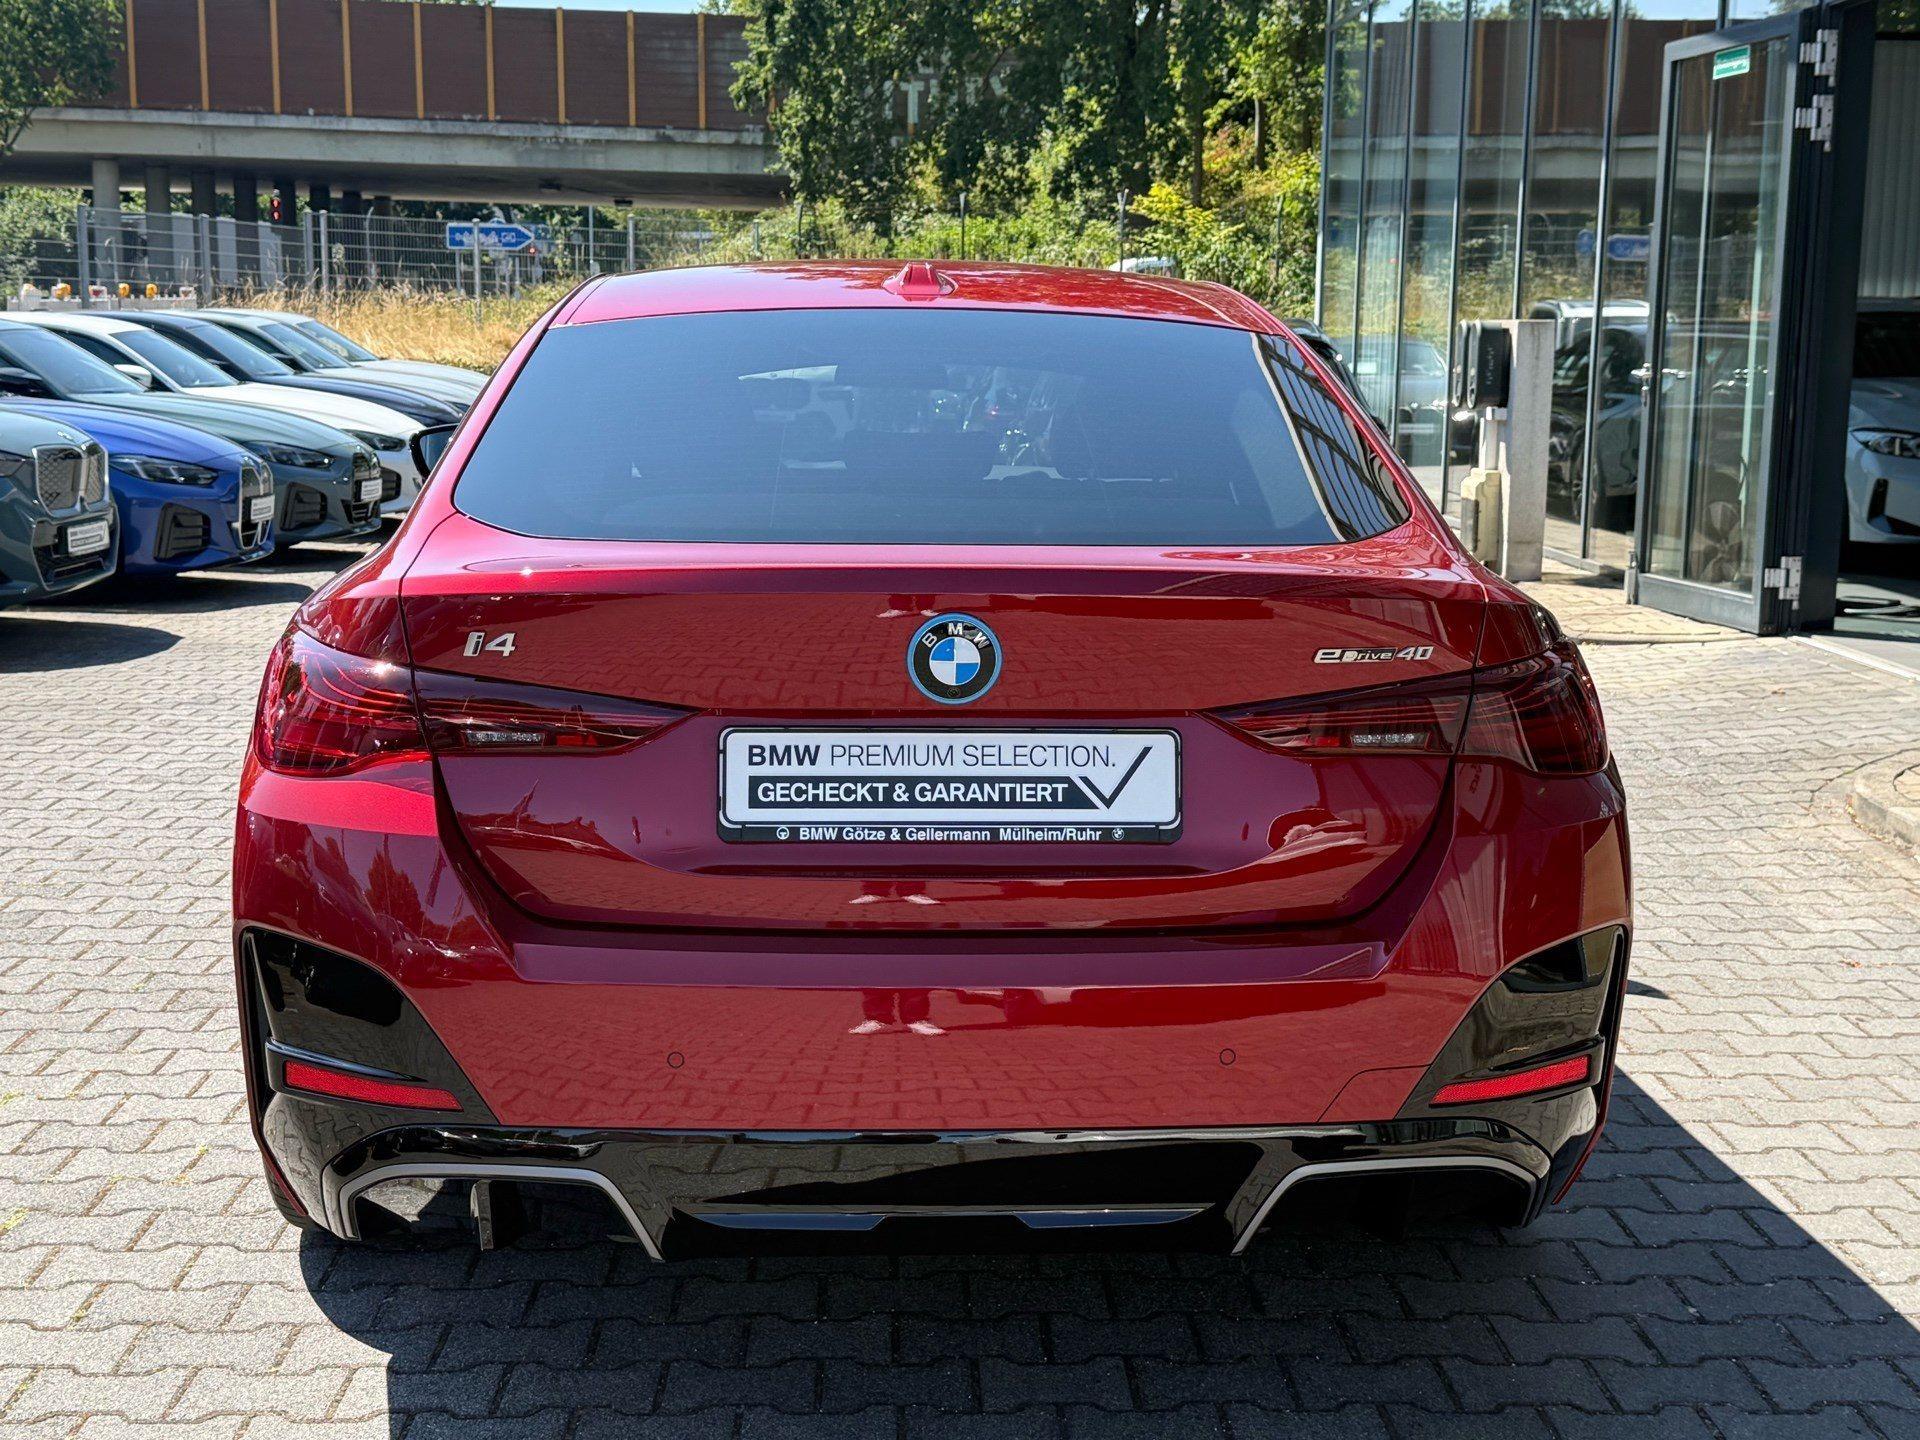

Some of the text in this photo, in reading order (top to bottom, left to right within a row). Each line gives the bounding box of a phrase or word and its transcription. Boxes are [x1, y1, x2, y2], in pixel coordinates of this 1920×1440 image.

[463, 631, 516, 657] i4
[921, 622, 990, 649] BMW
[748, 744, 1116, 767] BMW PREMIUM SELECTION.
[757, 782, 1069, 803] GECHECKT & GARANTIERT
[799, 826, 1102, 841] BMW Götze & Gellermann Mülheim/Ruhr
